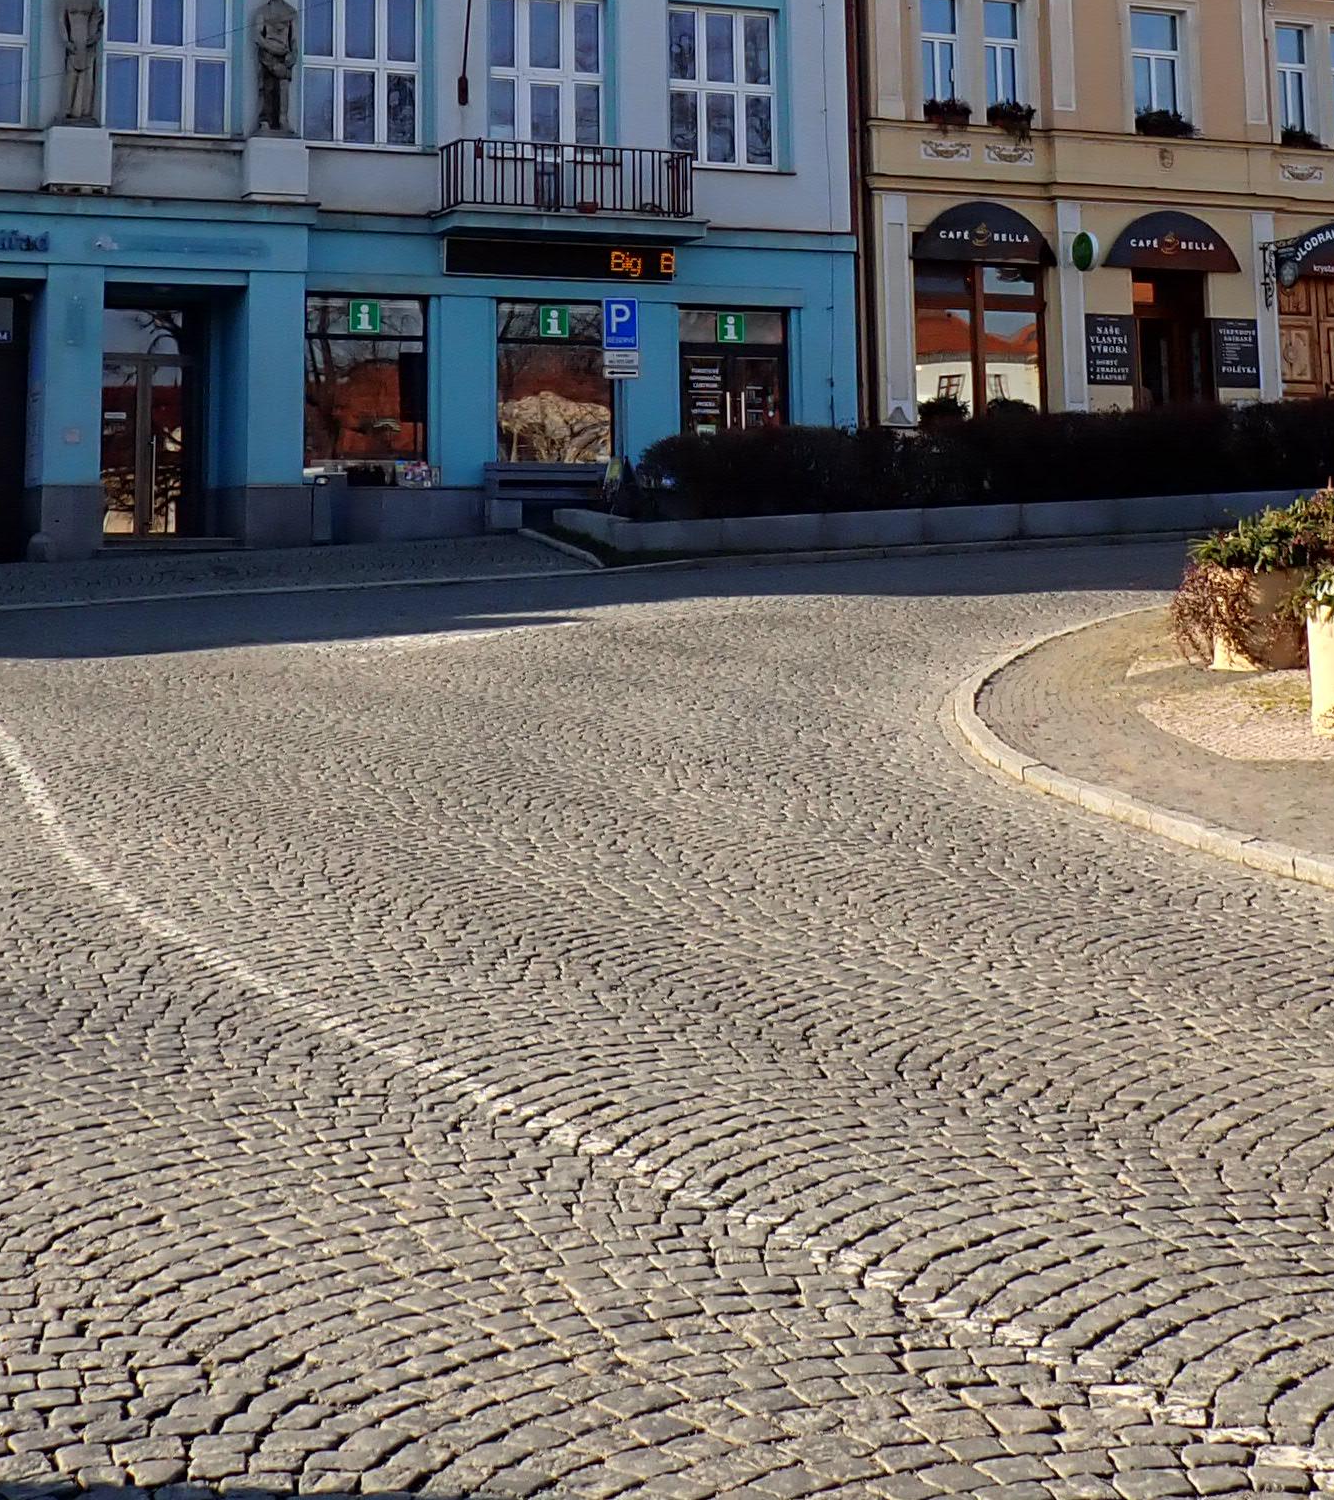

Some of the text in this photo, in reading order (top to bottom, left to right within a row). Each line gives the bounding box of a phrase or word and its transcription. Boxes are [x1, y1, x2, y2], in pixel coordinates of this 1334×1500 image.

[939, 229, 1030, 243] CAFÉ BELLA
[1130, 238, 1214, 251] CAFÉ BELLA
[610, 251, 642, 277] Big
[610, 304, 631, 333] P
[1090, 344, 1128, 354] VÝROBA
[1221, 365, 1257, 374] POLÉVKA
